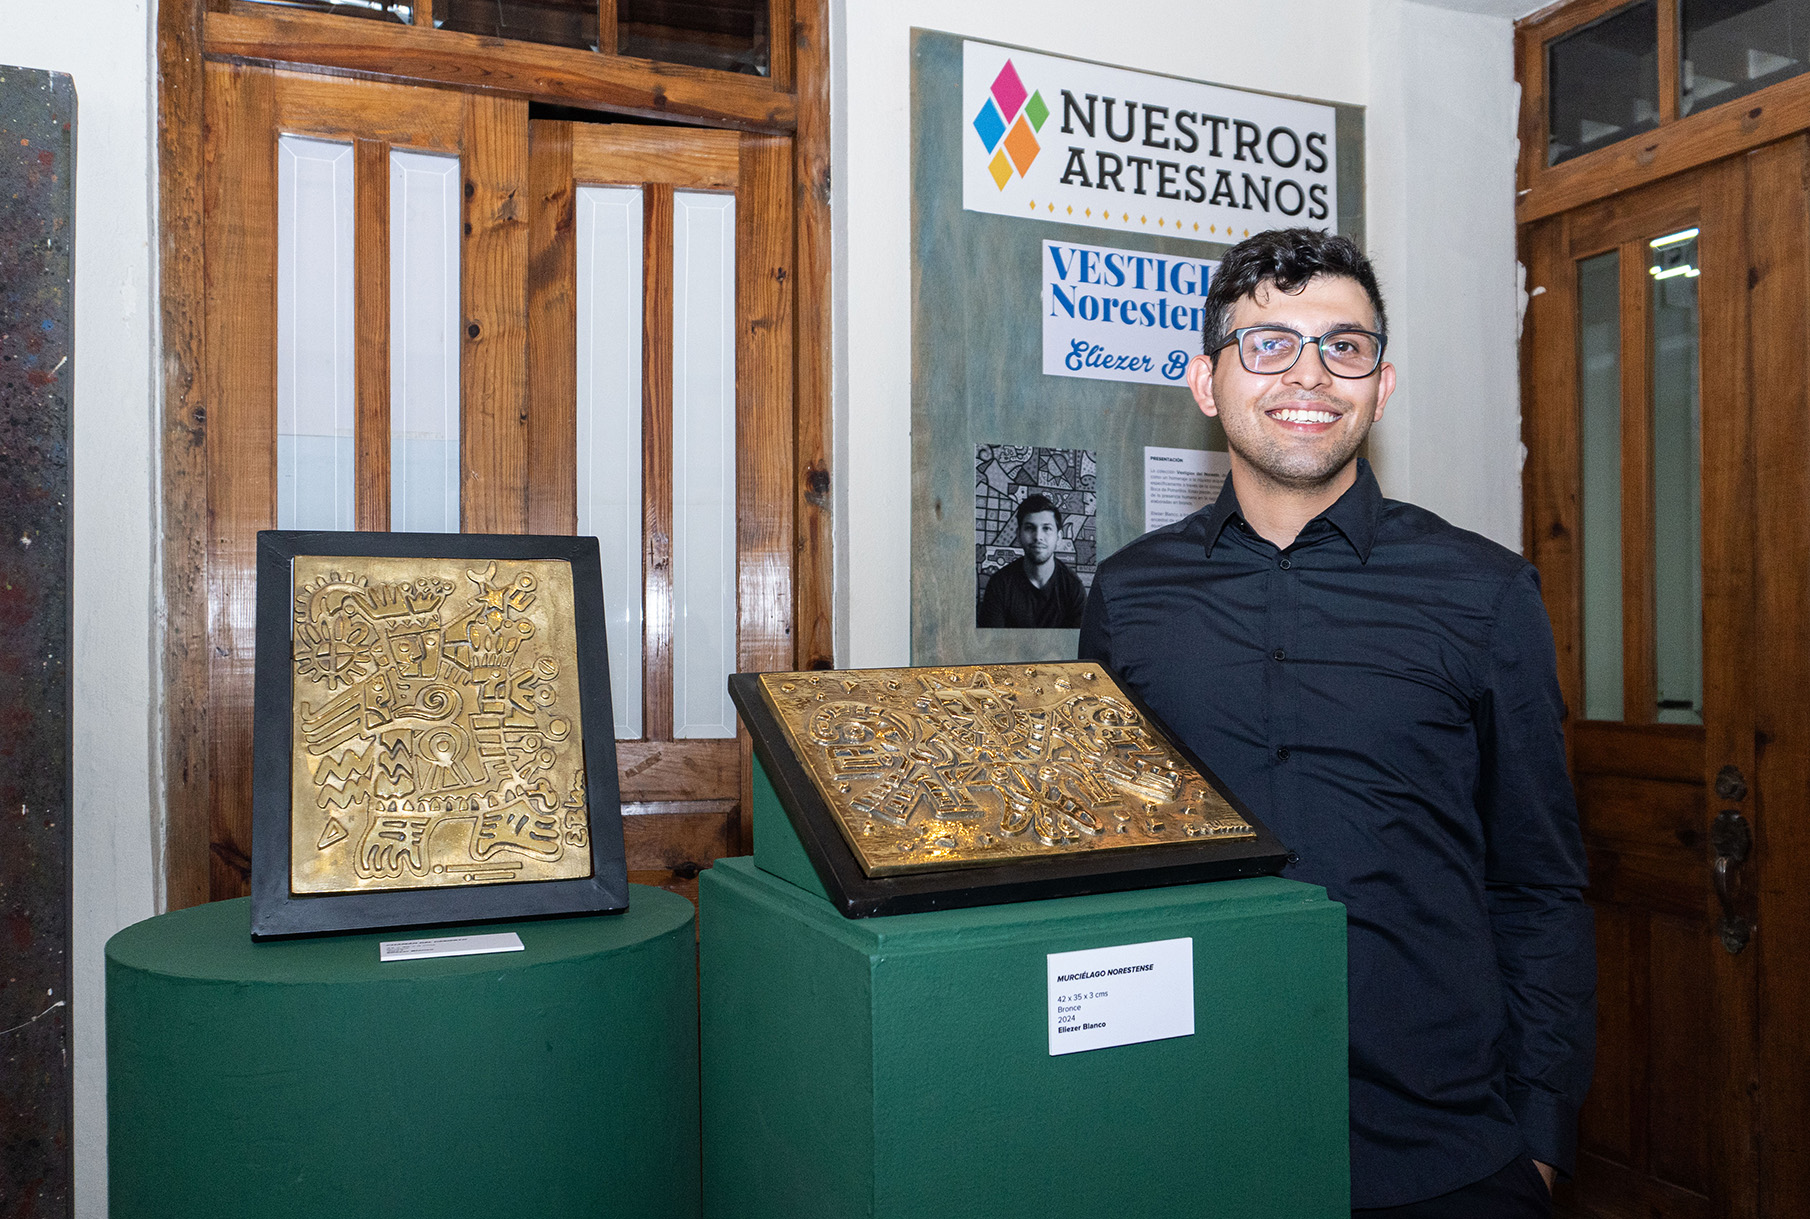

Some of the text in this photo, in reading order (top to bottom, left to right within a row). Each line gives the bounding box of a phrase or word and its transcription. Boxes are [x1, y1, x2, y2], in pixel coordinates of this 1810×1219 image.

[1060, 89, 1328, 174] NUESTROS
[1059, 146, 1329, 221] ARTESANOS
[1048, 245, 1212, 297] VESTIGI
[1050, 283, 1206, 332] Noresten
[1065, 338, 1189, 380] Eliezer B
[1057, 964, 1154, 982] MURCIÉLAGO NORESTENSE
[1057, 995, 1066, 1003] 42
[1074, 993, 1082, 1001] 35
[1058, 1004, 1082, 1013] Bronce
[1058, 1015, 1076, 1023] 2024
[1058, 1022, 1106, 1034] Eliezer Blanco
